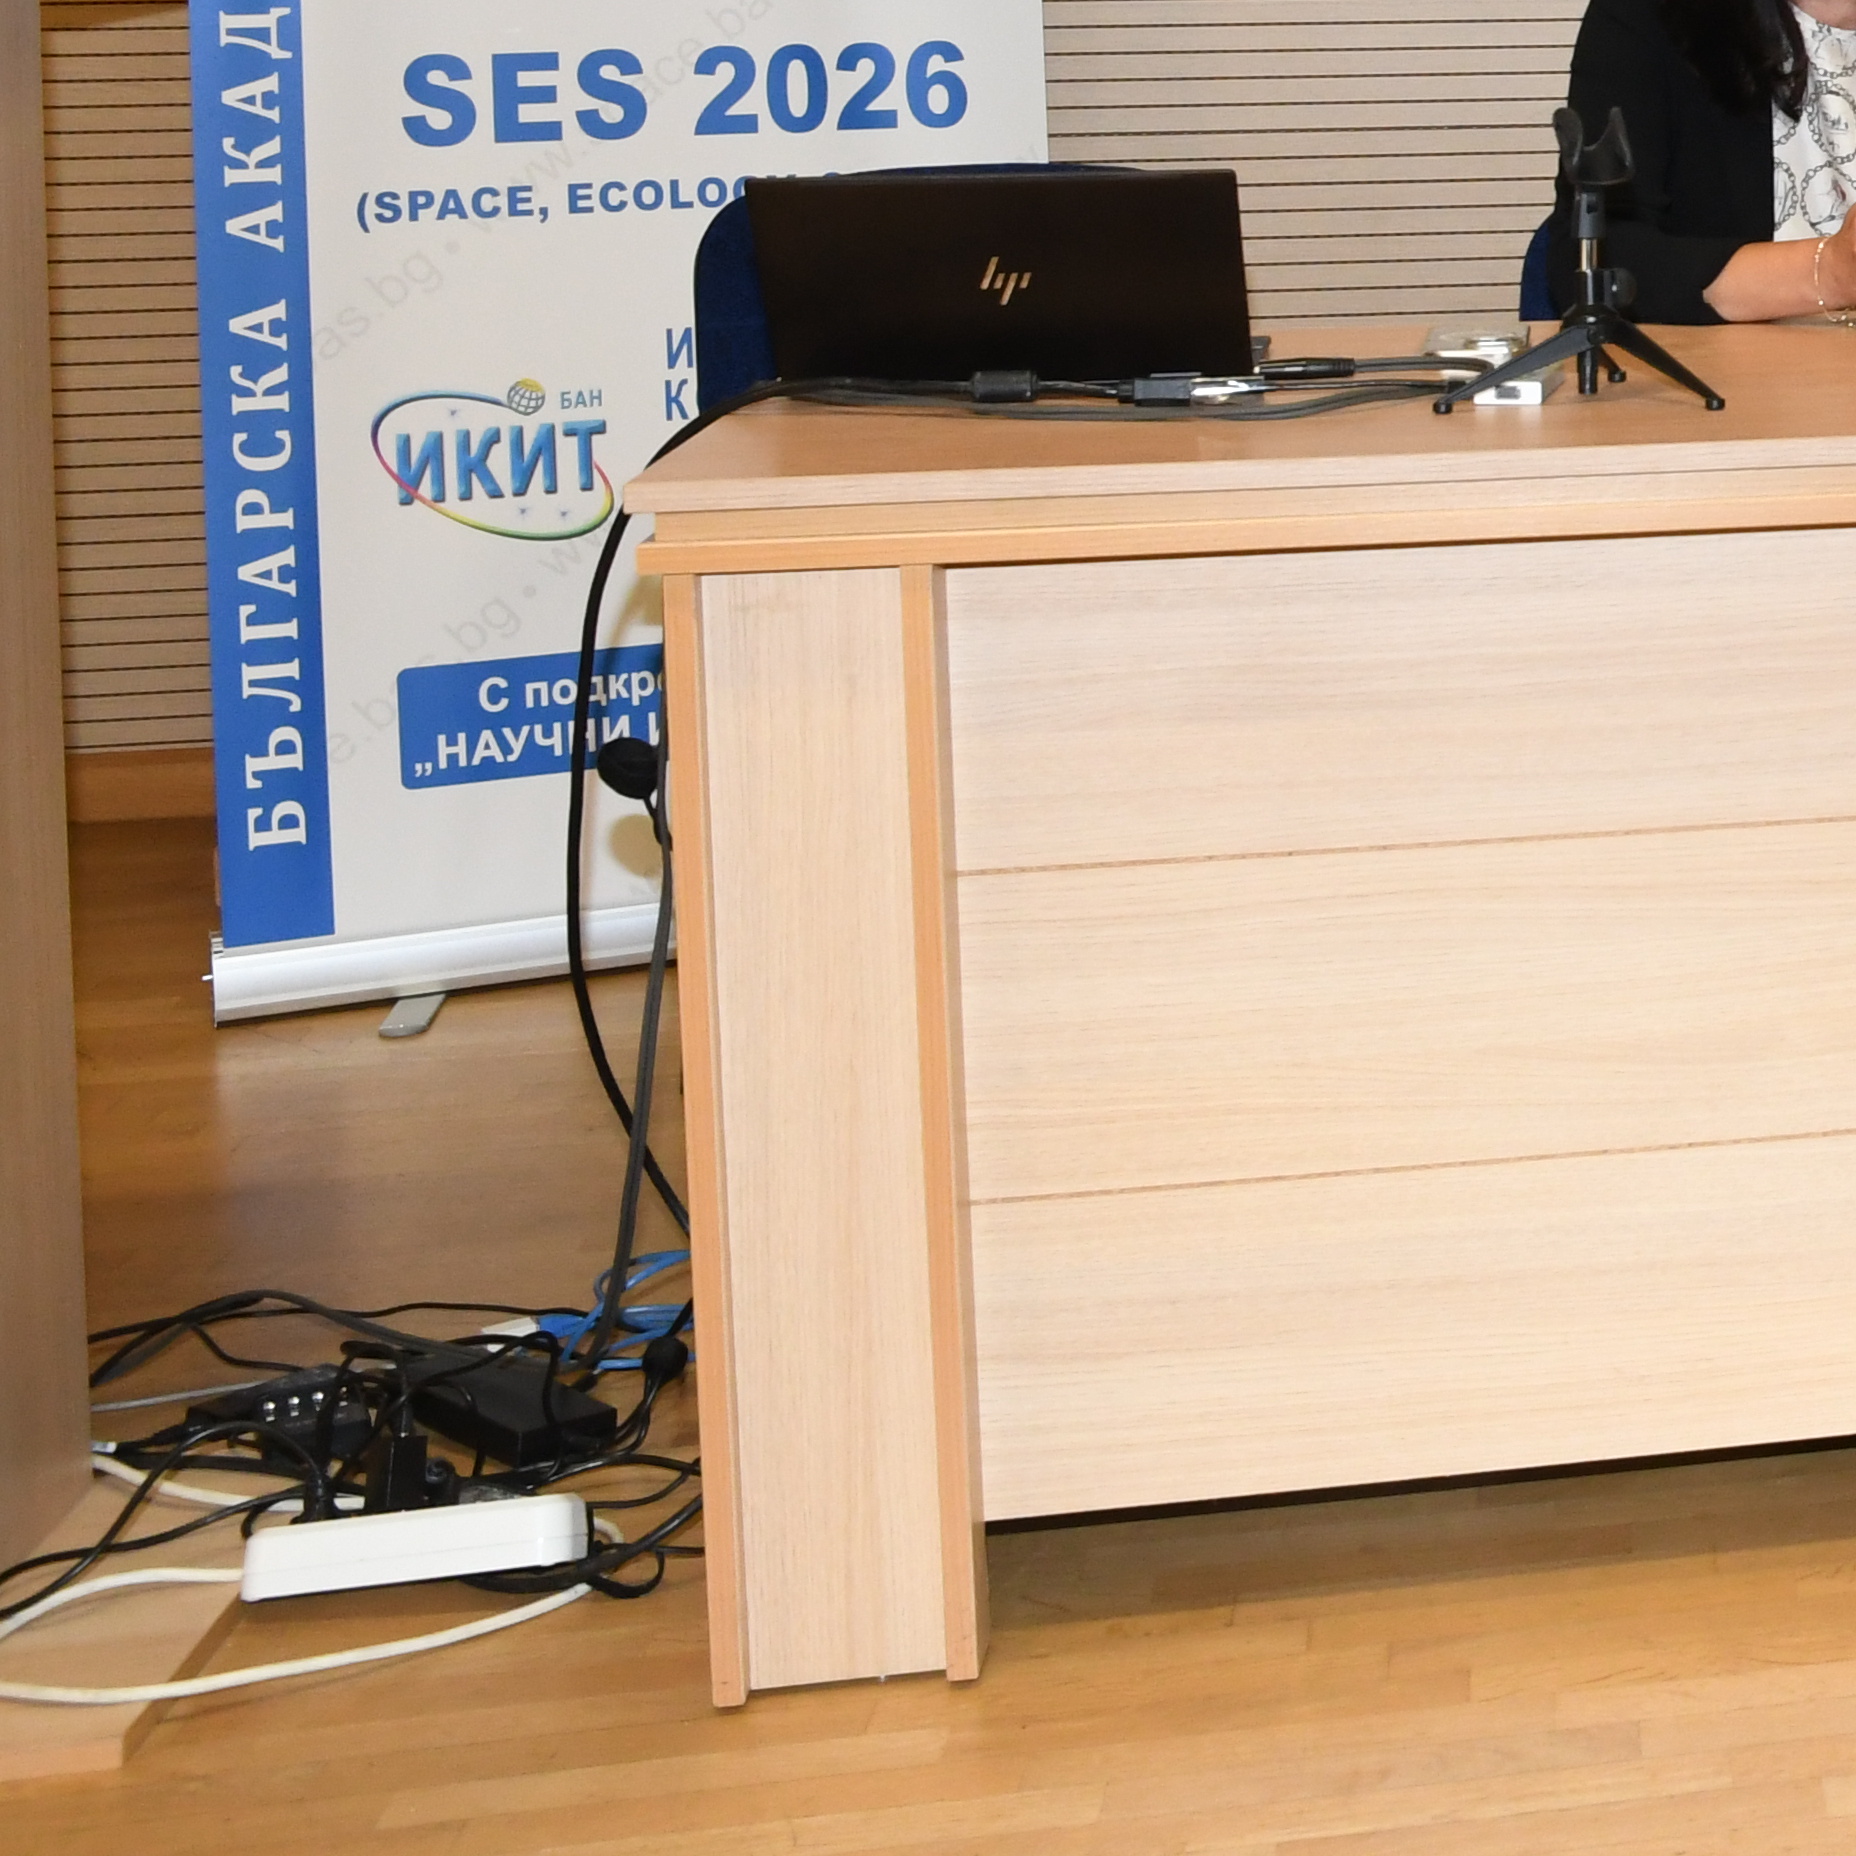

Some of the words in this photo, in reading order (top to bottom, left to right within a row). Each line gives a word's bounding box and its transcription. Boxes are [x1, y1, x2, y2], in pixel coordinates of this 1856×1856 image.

[401, 47, 649, 148] SES
[693, 39, 969, 136] 2026
[356, 184, 550, 233] (SPACE,
[567, 175, 796, 214] ECOLO
[980, 256, 1032, 306] hp
[560, 389, 602, 410] БАН
[396, 419, 607, 506] ИКИТ
[229, 297, 308, 851] БЪЛГАРСКА
[478, 676, 510, 713] С
